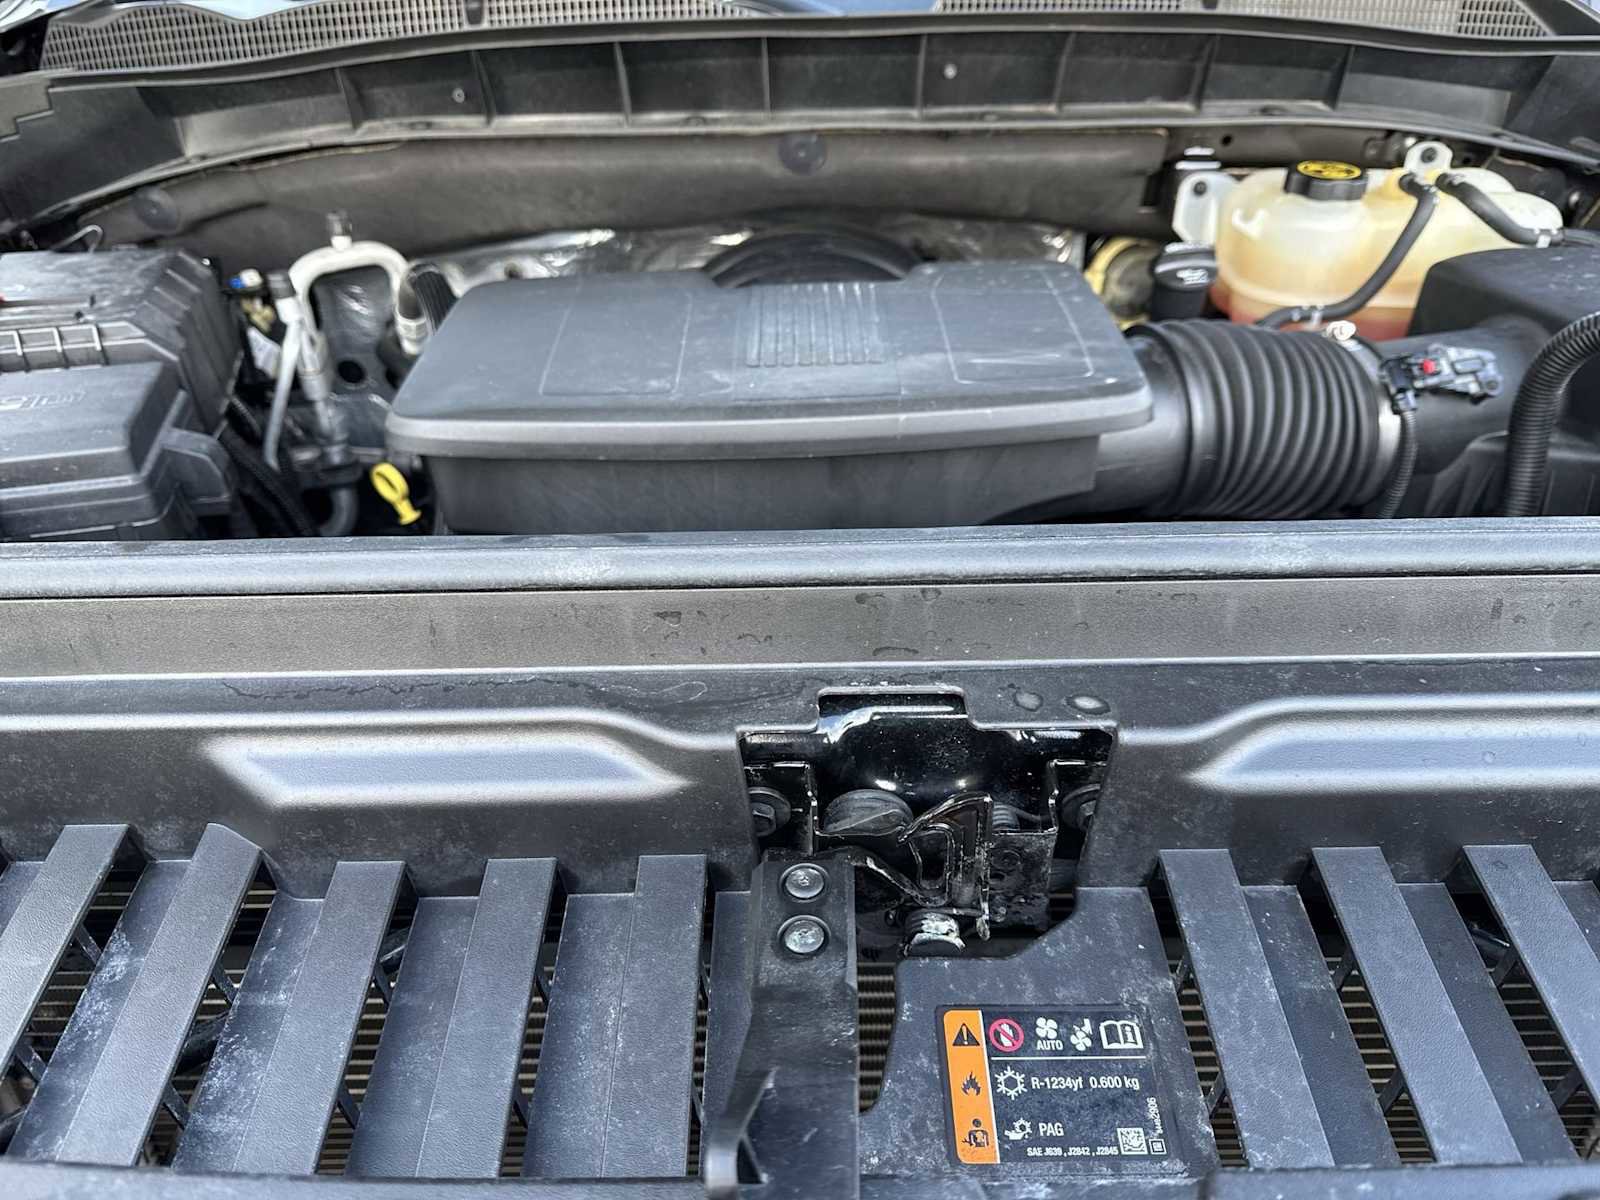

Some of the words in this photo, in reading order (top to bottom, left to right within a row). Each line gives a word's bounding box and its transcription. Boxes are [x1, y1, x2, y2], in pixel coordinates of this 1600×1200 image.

[1036, 1039, 1063, 1051] AUTO
[1031, 1076, 1083, 1091] R-1234yf
[1089, 1076, 1122, 1089] 0.600
[1123, 1075, 1140, 1090] kg
[1039, 1122, 1064, 1137] PAG
[1026, 1147, 1042, 1156] SAE
